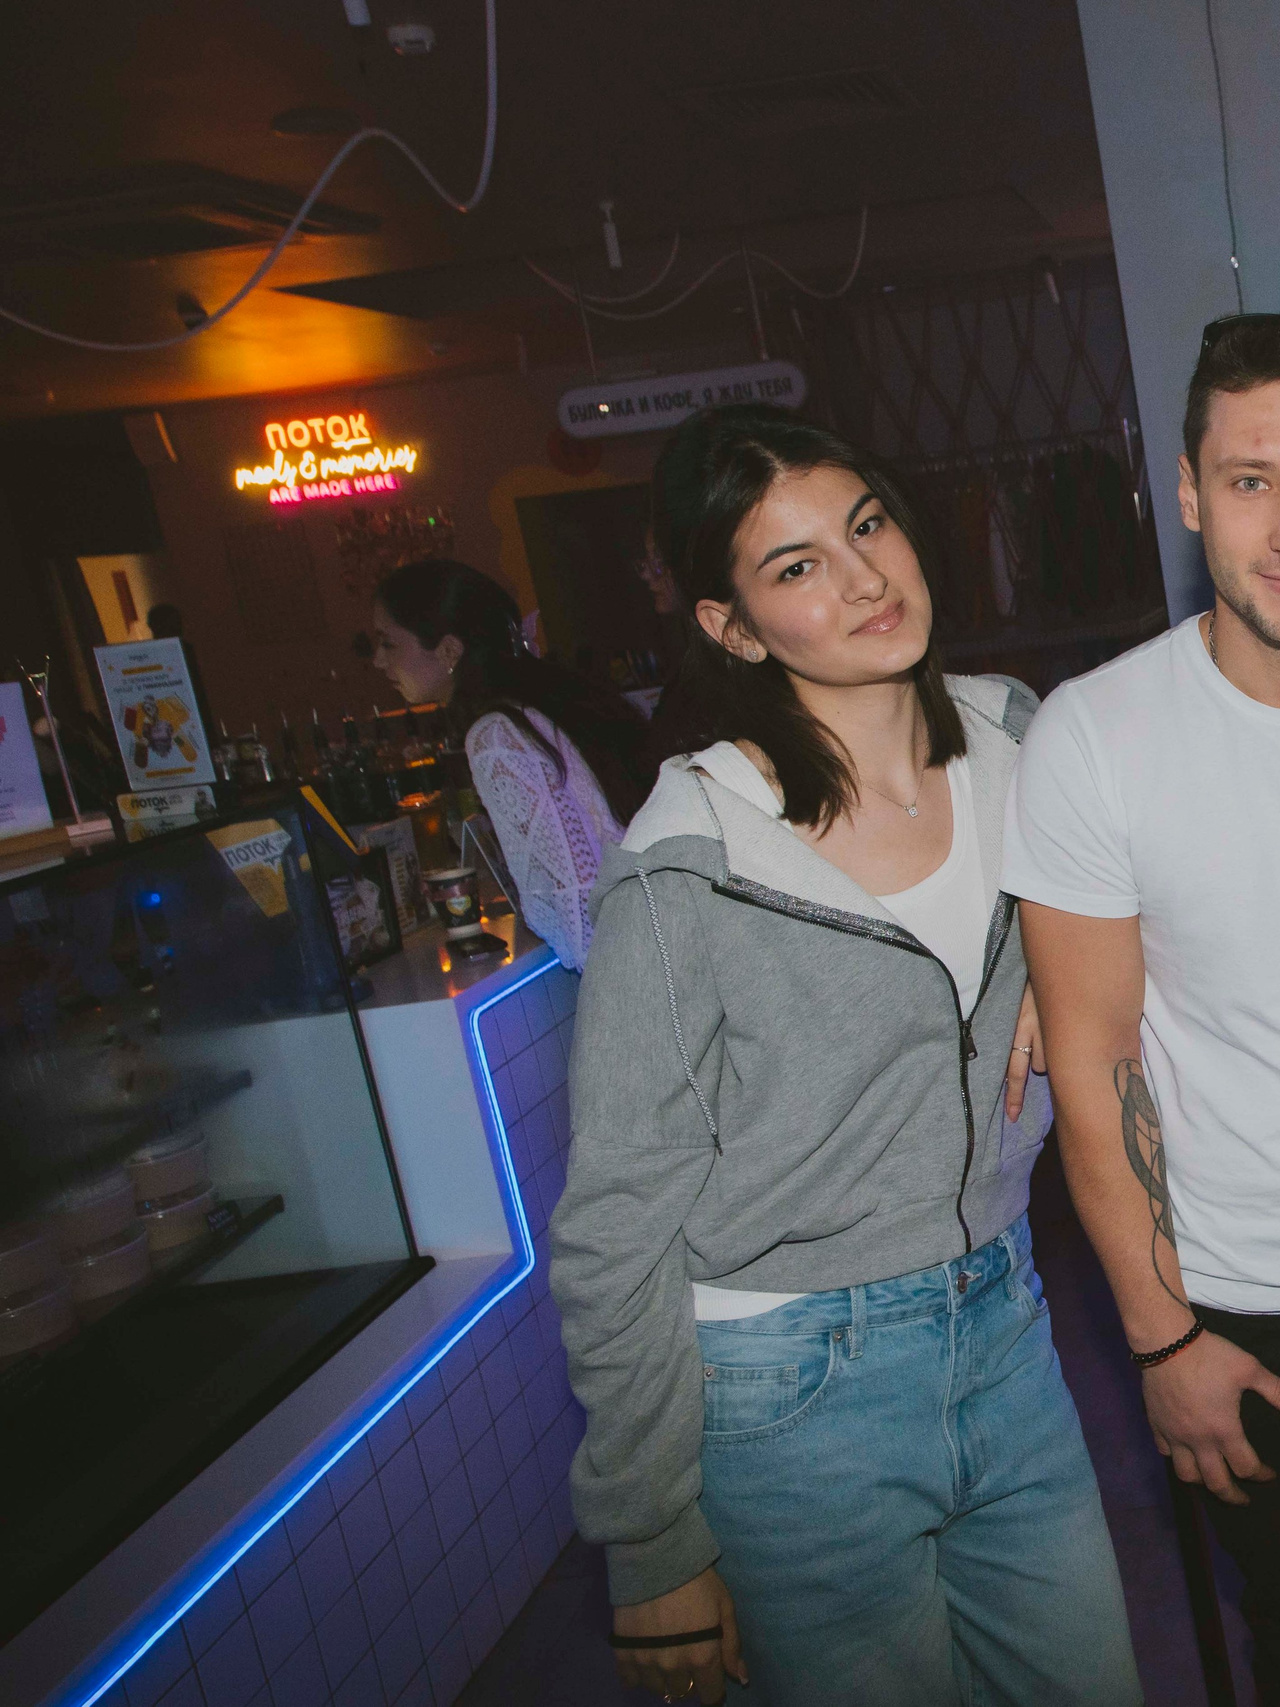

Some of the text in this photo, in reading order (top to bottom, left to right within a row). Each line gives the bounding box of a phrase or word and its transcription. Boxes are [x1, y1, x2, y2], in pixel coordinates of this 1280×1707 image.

[639, 396, 650, 415] И
[703, 386, 713, 404] Я
[756, 376, 793, 397] ТЕБЯ
[265, 413, 370, 450] ПОТОК
[269, 473, 397, 504] ARE MADE HERE
[224, 837, 278, 867] ПОТОК
